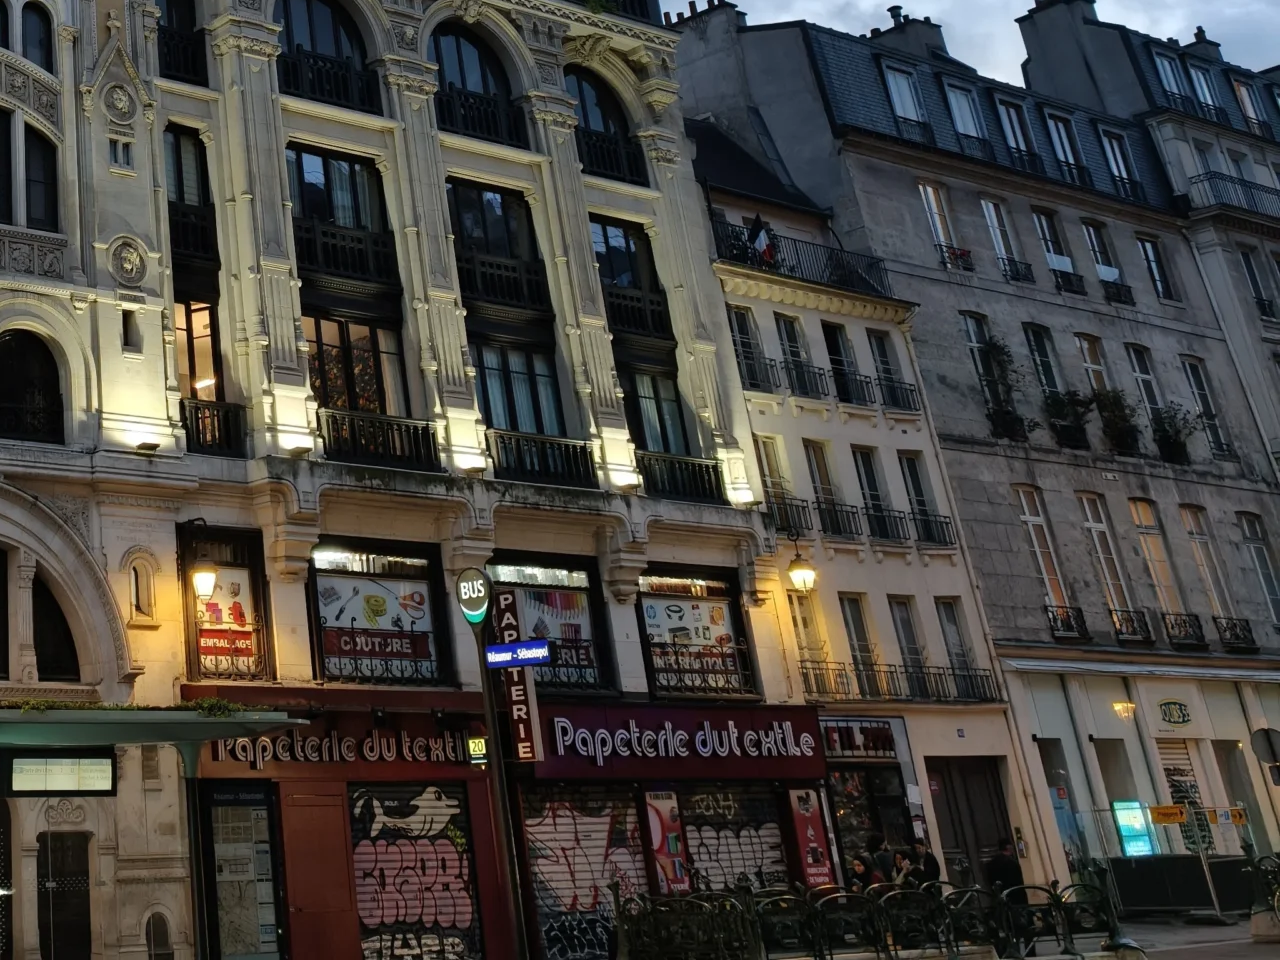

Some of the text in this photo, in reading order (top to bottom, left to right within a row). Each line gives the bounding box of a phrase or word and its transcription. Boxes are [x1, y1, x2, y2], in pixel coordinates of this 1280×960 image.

[459, 579, 485, 600] BUS
[487, 651, 512, 663] Réaumur
[517, 645, 549, 660] Sébastopol
[499, 593, 533, 759] PAPTERIE
[363, 729, 397, 762] du
[471, 740, 484, 753] 20
[553, 717, 690, 767] Papeterie
